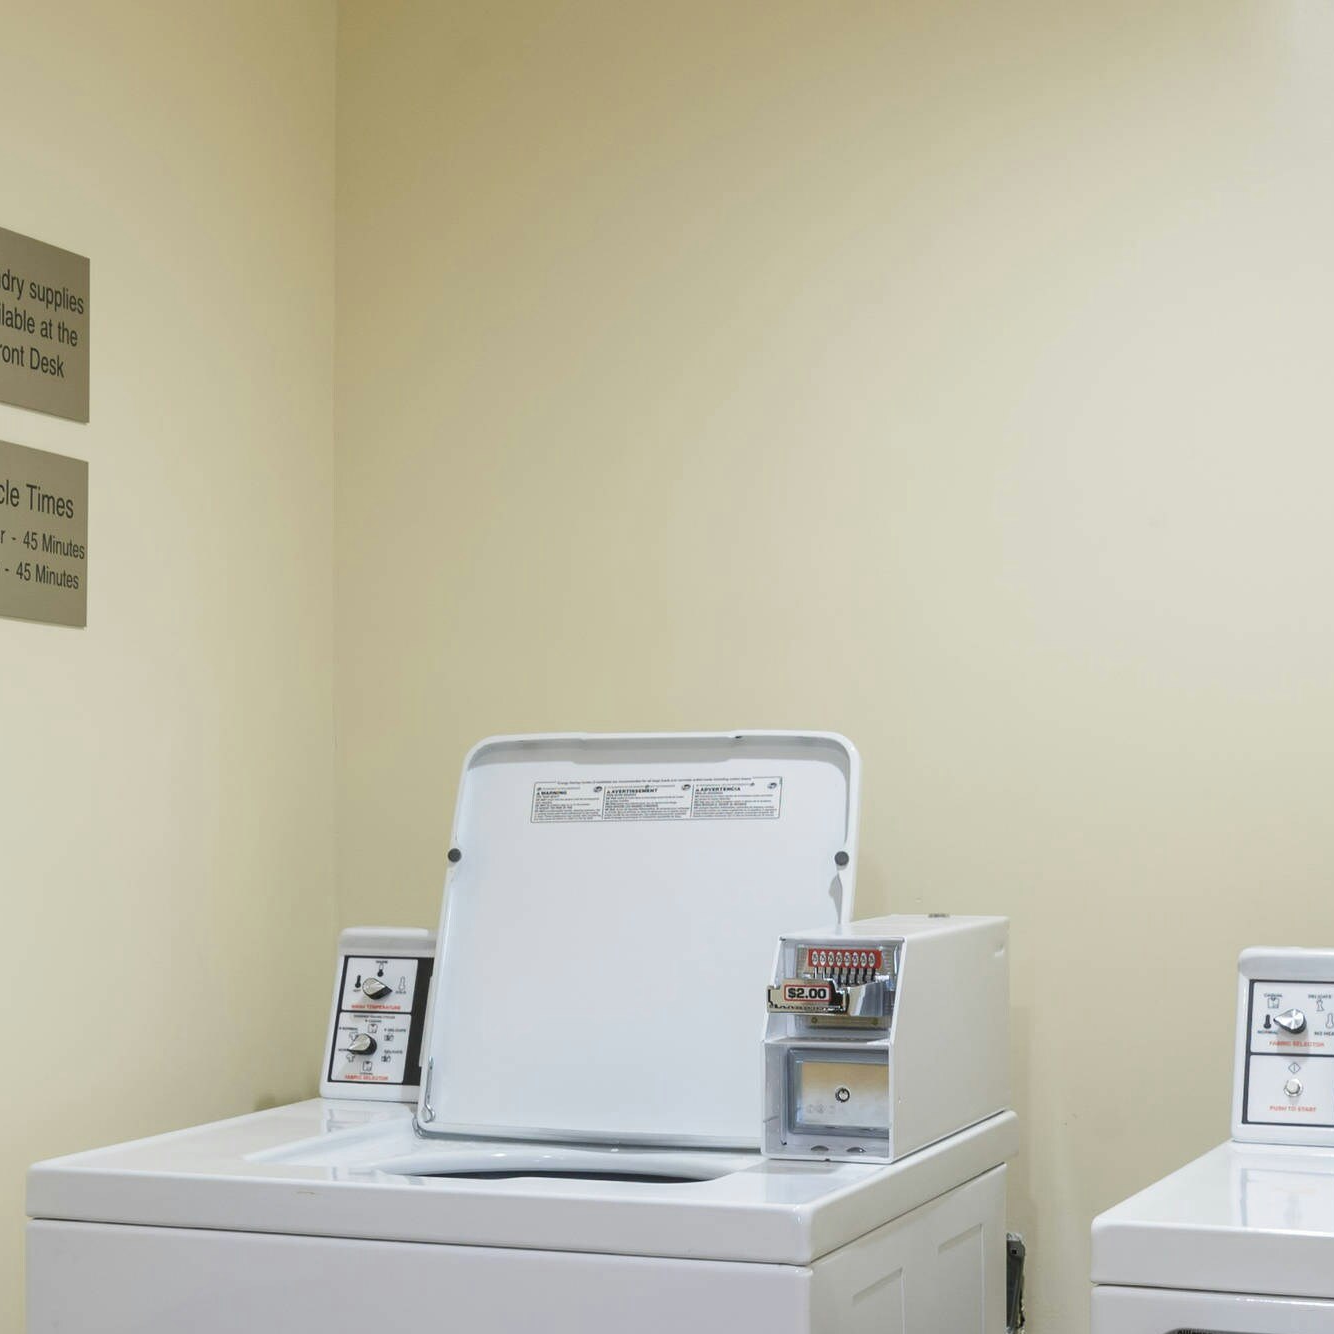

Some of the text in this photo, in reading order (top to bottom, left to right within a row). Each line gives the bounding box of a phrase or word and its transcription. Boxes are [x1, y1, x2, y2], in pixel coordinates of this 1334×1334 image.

[29, 281, 85, 315] supplies
[40, 319, 53, 340] at
[57, 322, 78, 347] the
[30, 347, 65, 378] Desk
[26, 483, 74, 519] Times
[23, 530, 38, 551] 45
[42, 533, 86, 560] Minutes
[16, 562, 32, 582] 45
[35, 564, 80, 590] Minutes
[788, 986, 827, 1000] $2.00
